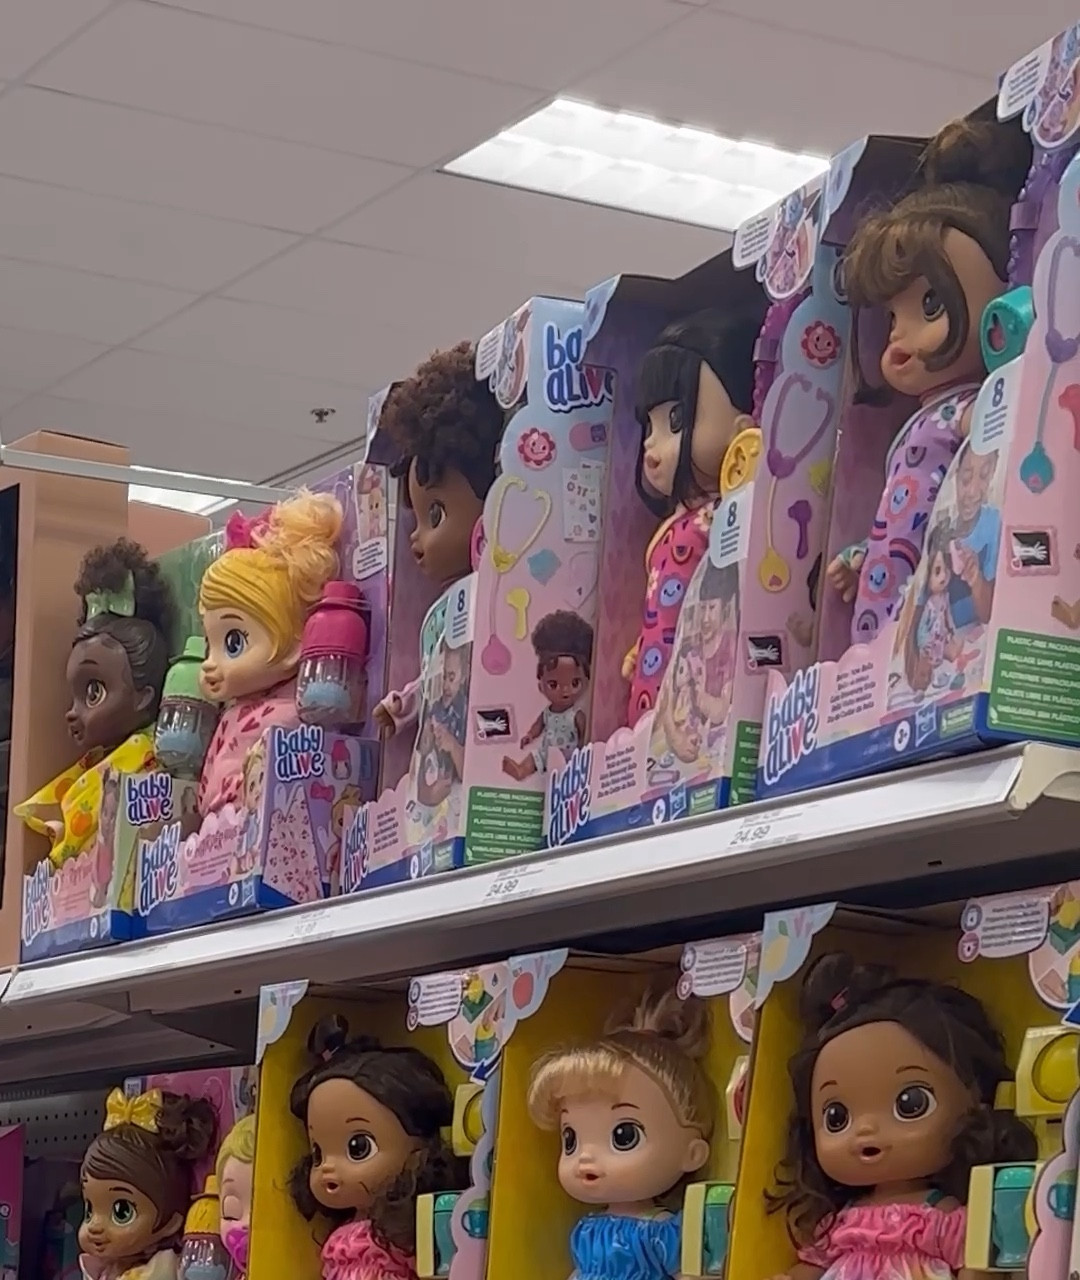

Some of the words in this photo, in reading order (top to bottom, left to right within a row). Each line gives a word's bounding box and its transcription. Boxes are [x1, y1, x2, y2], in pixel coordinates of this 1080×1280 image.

[546, 324, 584, 370] ba
[991, 377, 1004, 407] 8
[726, 501, 737, 527] 8
[456, 588, 465, 611] 8
[768, 662, 820, 739] baby
[276, 725, 323, 755] baby
[764, 708, 818, 785] alive
[127, 773, 171, 801] baby
[276, 751, 325, 780] alive
[550, 743, 593, 816] baby
[126, 797, 173, 824] alive
[548, 786, 590, 848] alive
[140, 823, 181, 879] baby
[25, 859, 50, 904] baby
[138, 862, 178, 914] alive
